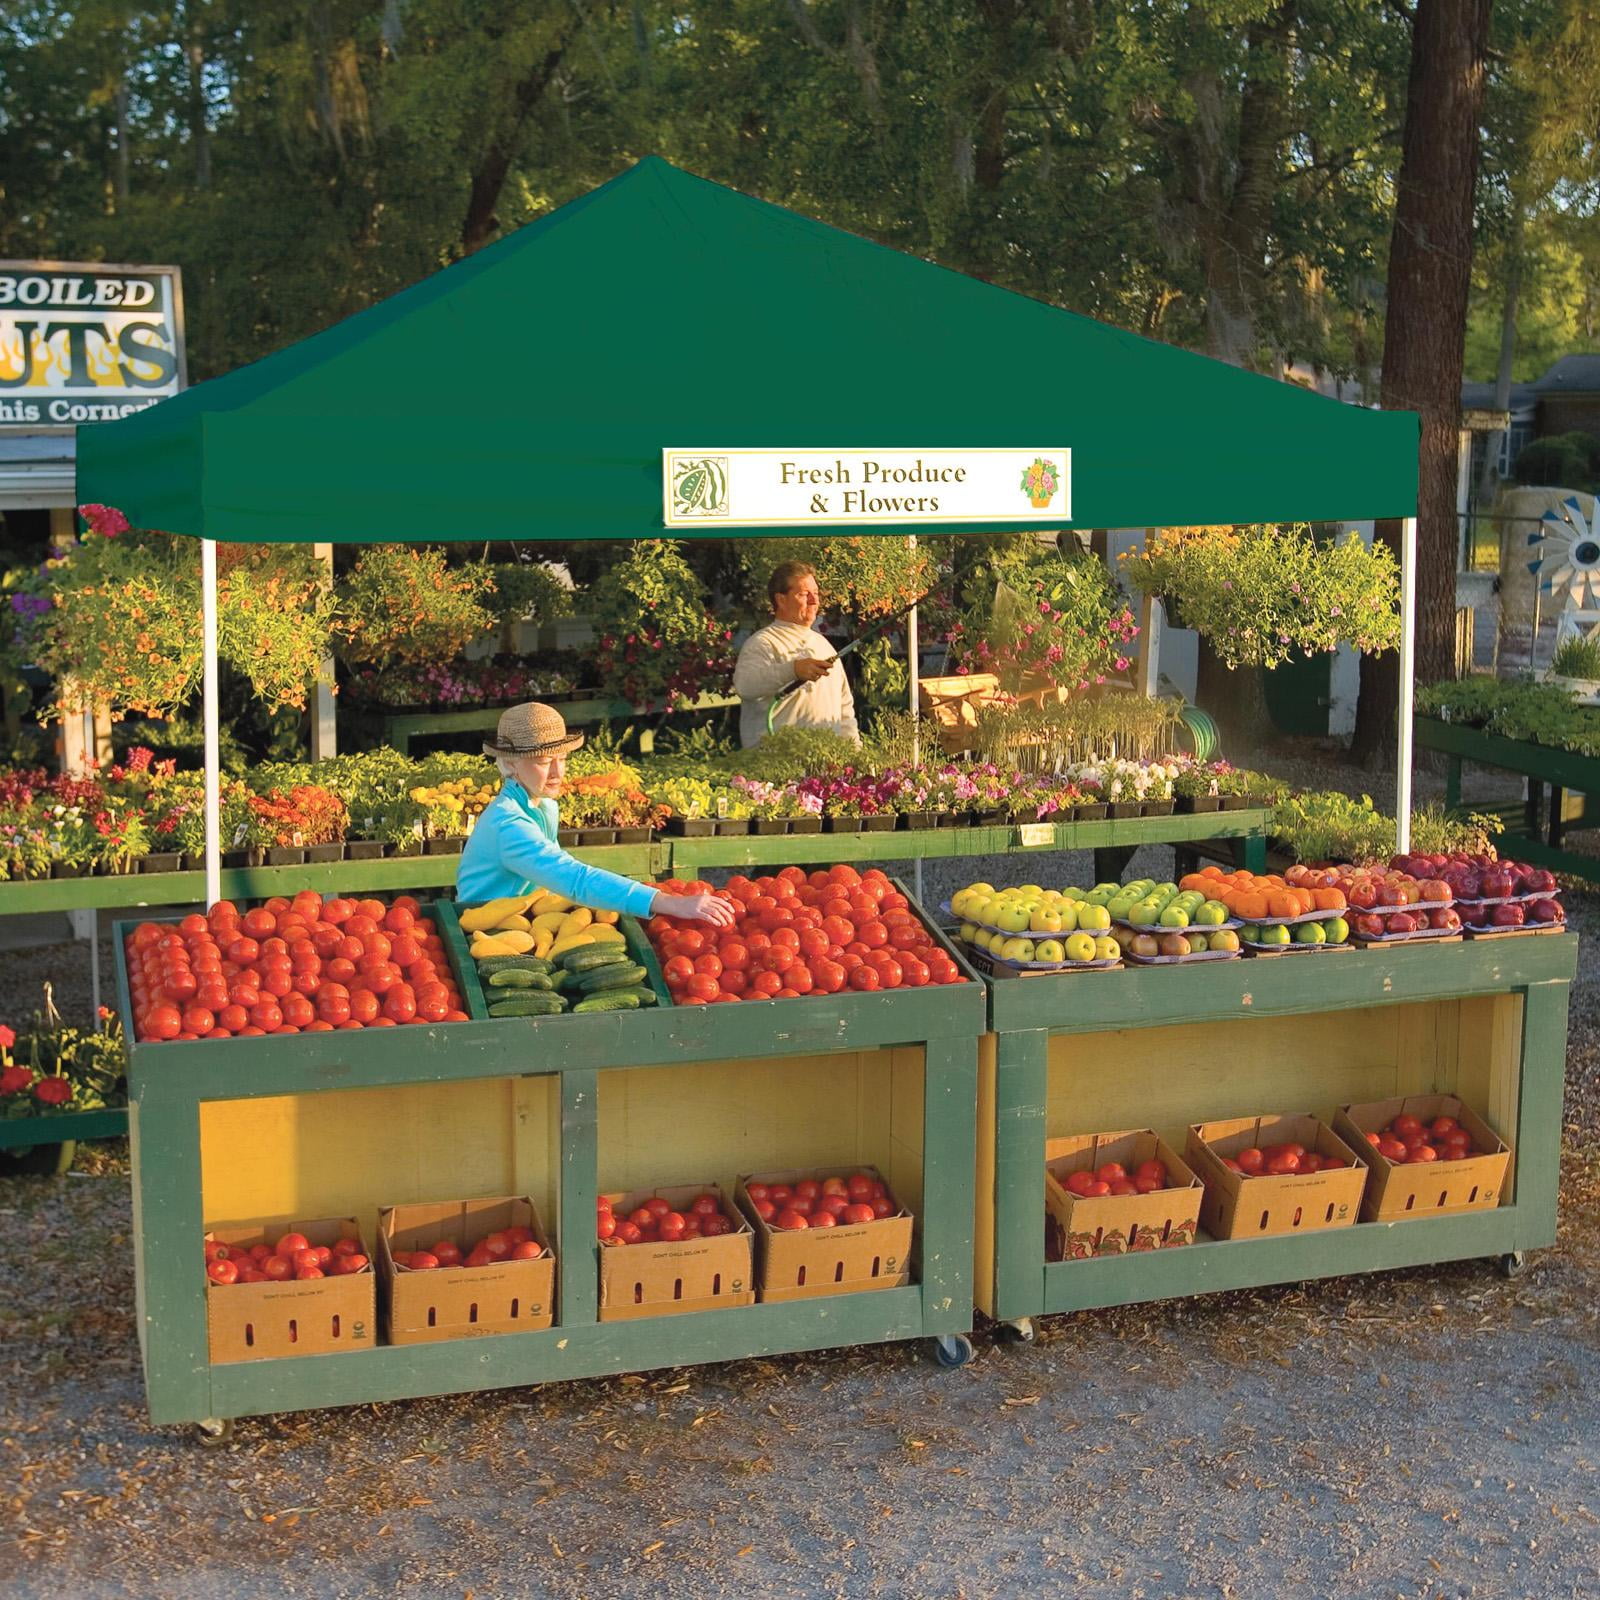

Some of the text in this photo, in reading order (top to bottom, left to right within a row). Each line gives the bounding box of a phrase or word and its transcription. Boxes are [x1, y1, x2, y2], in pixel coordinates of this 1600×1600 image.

[780, 459, 967, 484] Fresh Produce
[810, 489, 939, 513] & Flowers
